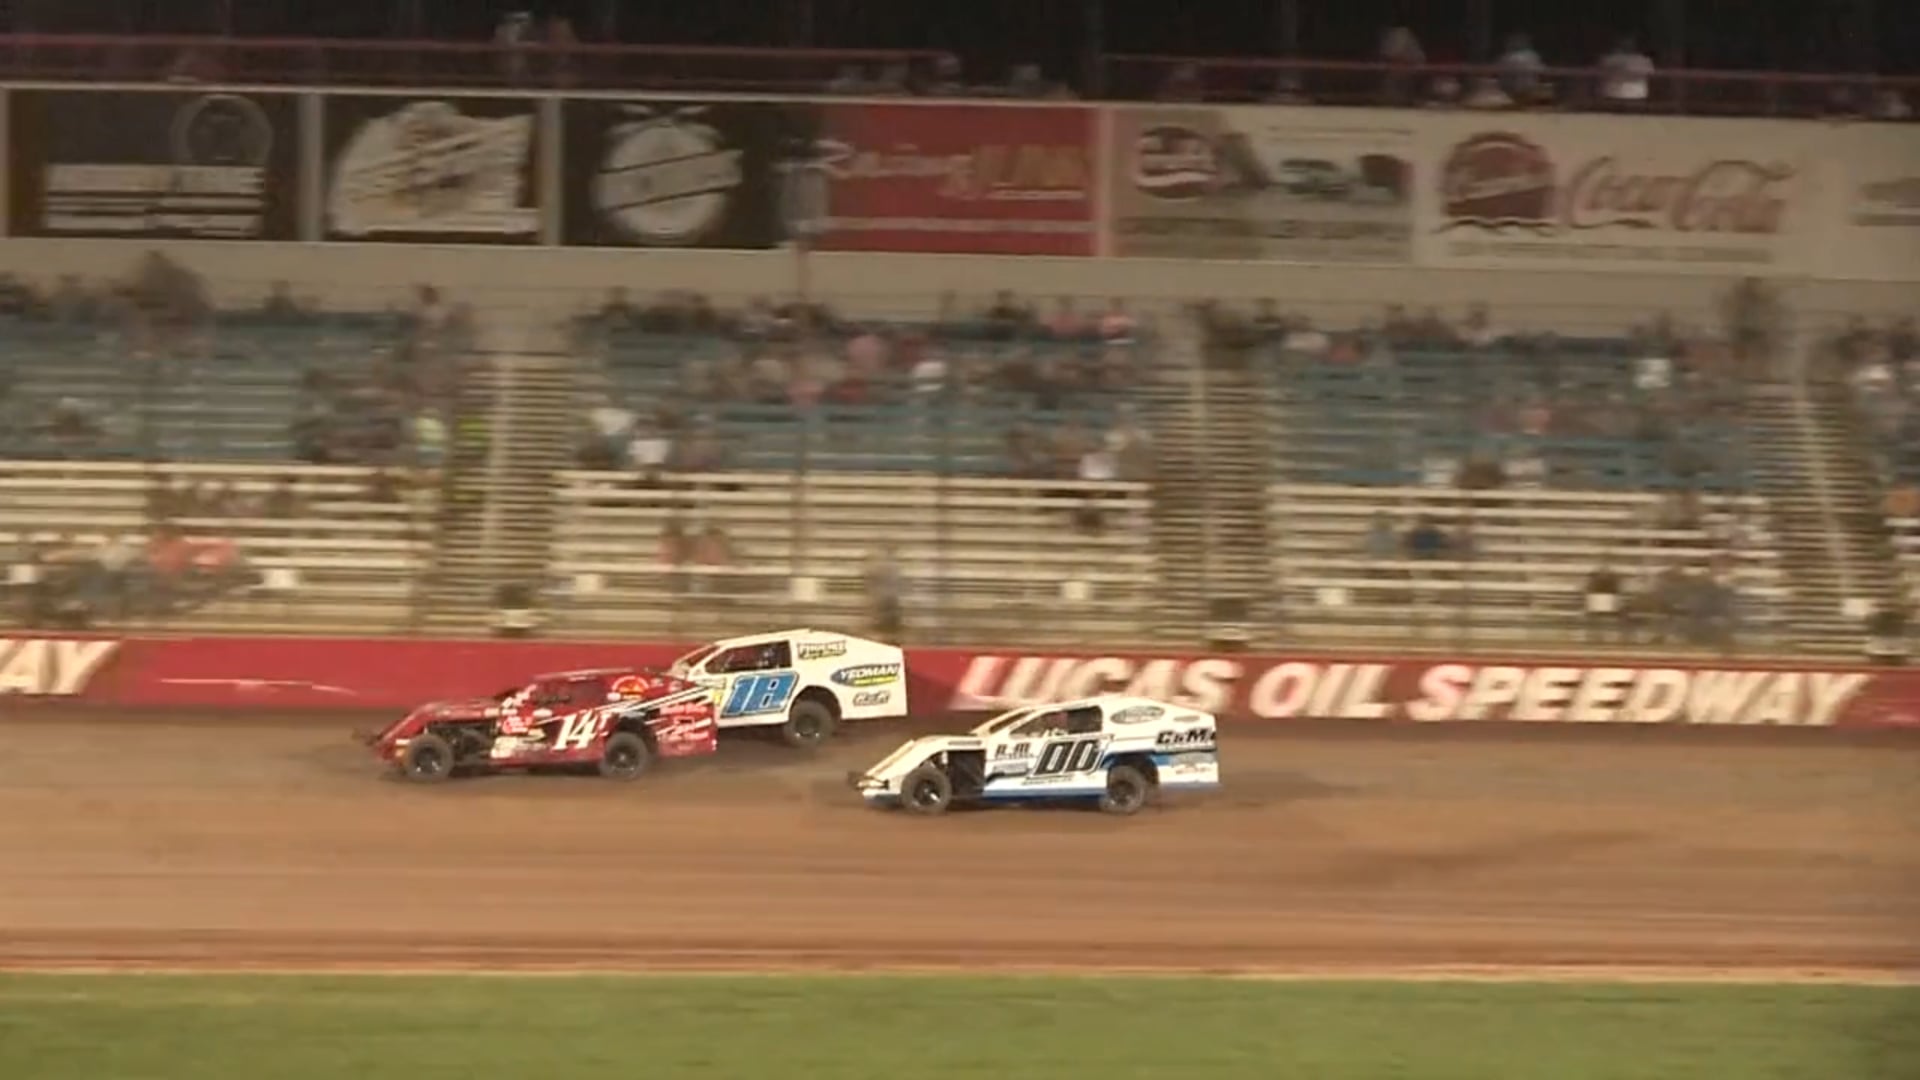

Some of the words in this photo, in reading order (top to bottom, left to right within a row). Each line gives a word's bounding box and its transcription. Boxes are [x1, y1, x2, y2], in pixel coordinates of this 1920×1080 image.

[0, 638, 119, 695] AY
[839, 664, 900, 681] YEOMAN
[722, 671, 799, 718] 18
[953, 655, 1242, 713] LUCAS
[1249, 661, 1397, 719] OIL
[1409, 664, 1870, 727] SPEEDWAY
[1033, 739, 1103, 777] 00
